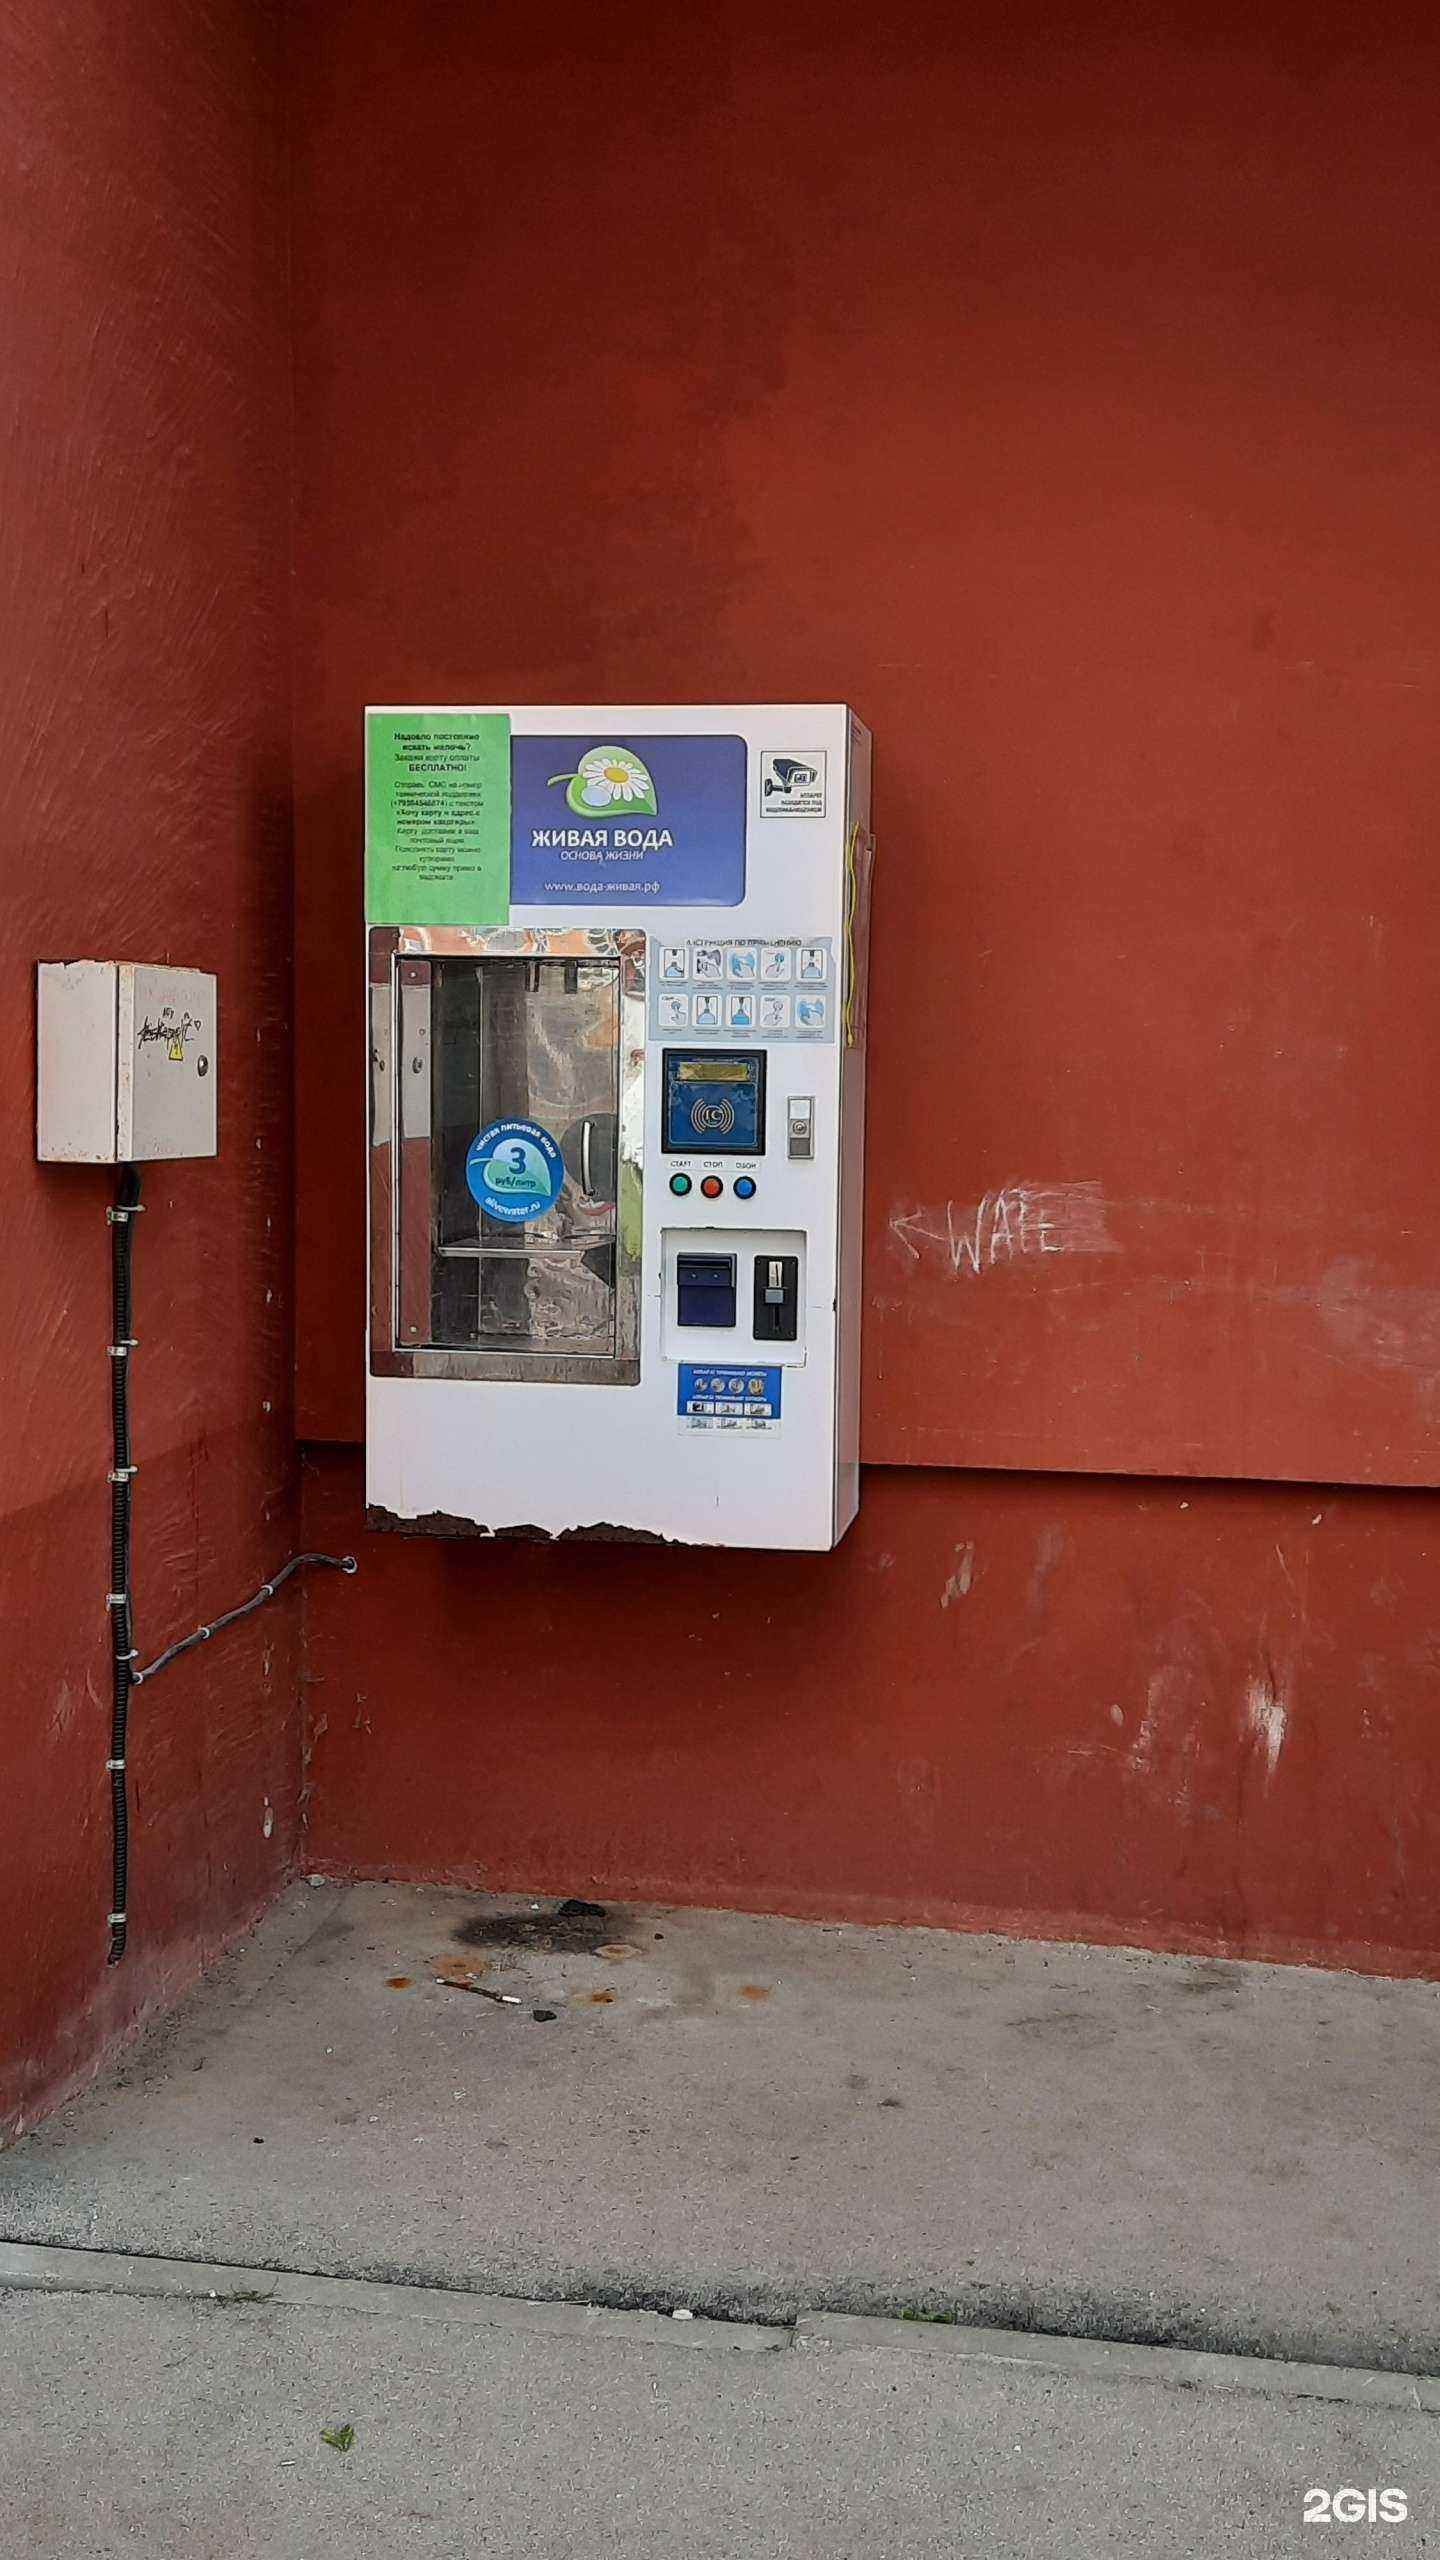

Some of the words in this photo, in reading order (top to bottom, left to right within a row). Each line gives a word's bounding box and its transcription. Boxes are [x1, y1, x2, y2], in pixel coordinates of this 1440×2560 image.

[408, 763, 467, 772] БЕСПЛАТНО!
[532, 830, 608, 847] ЖИВАЯ
[614, 830, 673, 851] ВОДА
[560, 850, 602, 861] ОСНОВА
[605, 850, 644, 861] ЖИЗНИ
[544, 881, 660, 893] www.вода-живая.рф
[508, 1147, 526, 1175] 3
[495, 1176, 536, 1189] руб/литр
